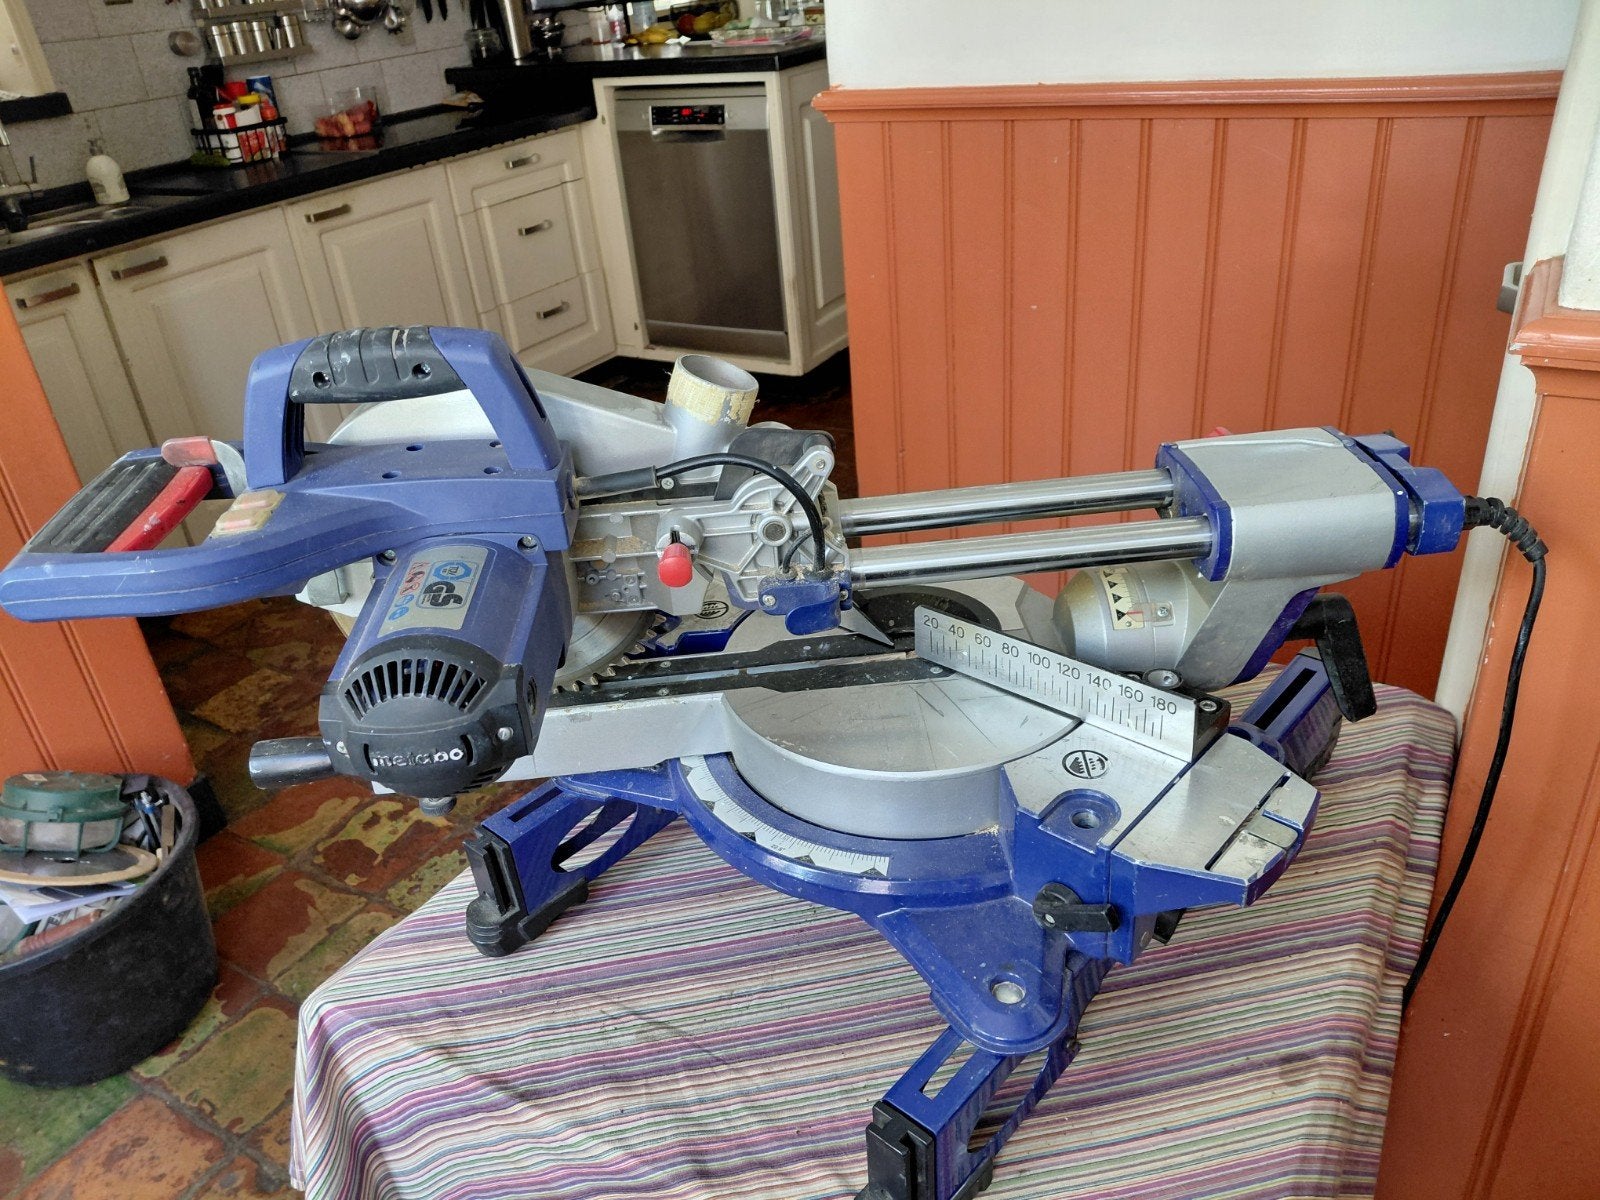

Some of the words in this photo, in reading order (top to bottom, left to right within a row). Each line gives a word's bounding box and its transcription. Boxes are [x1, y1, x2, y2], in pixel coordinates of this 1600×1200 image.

[923, 614, 939, 629] 20
[948, 624, 965, 639] 40
[974, 632, 992, 648] 60
[1002, 642, 1019, 658] 80
[1027, 651, 1051, 669] 100
[1056, 662, 1081, 680] 120
[1086, 673, 1112, 691] 140
[1118, 684, 1144, 703] 160
[1150, 695, 1177, 715] 180
